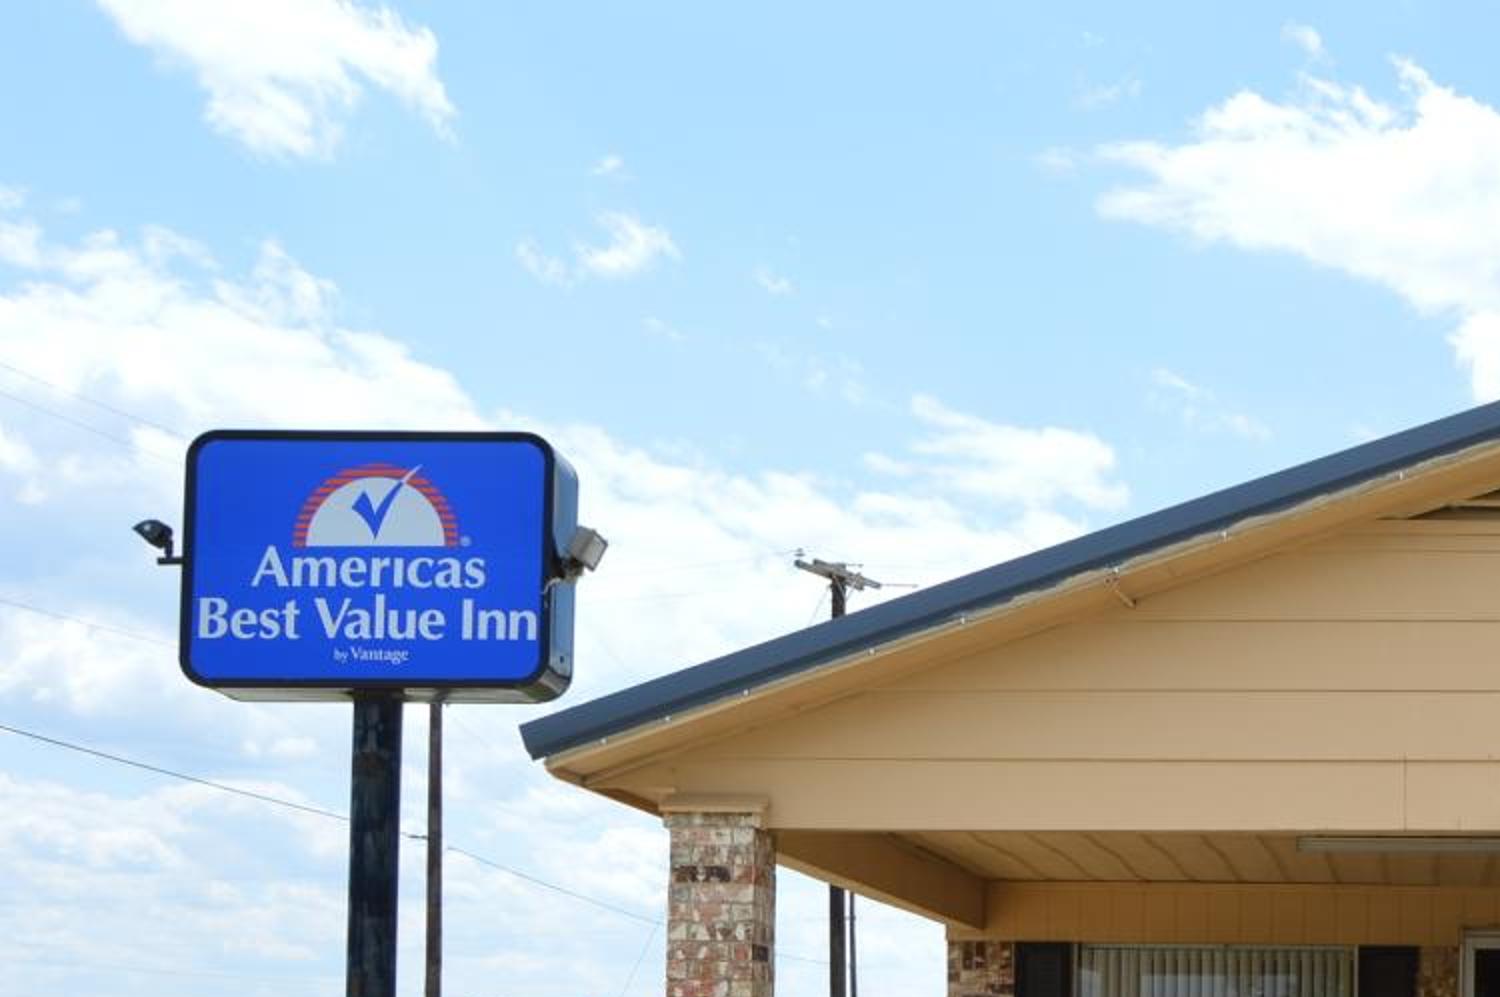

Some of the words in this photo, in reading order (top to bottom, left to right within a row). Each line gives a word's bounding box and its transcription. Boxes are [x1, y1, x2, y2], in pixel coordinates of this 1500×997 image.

[250, 544, 487, 589] Americas
[197, 595, 300, 640] Best
[313, 593, 446, 640] Value
[460, 597, 538, 641] Inn
[333, 647, 349, 665] by
[350, 645, 410, 665] Vantage
